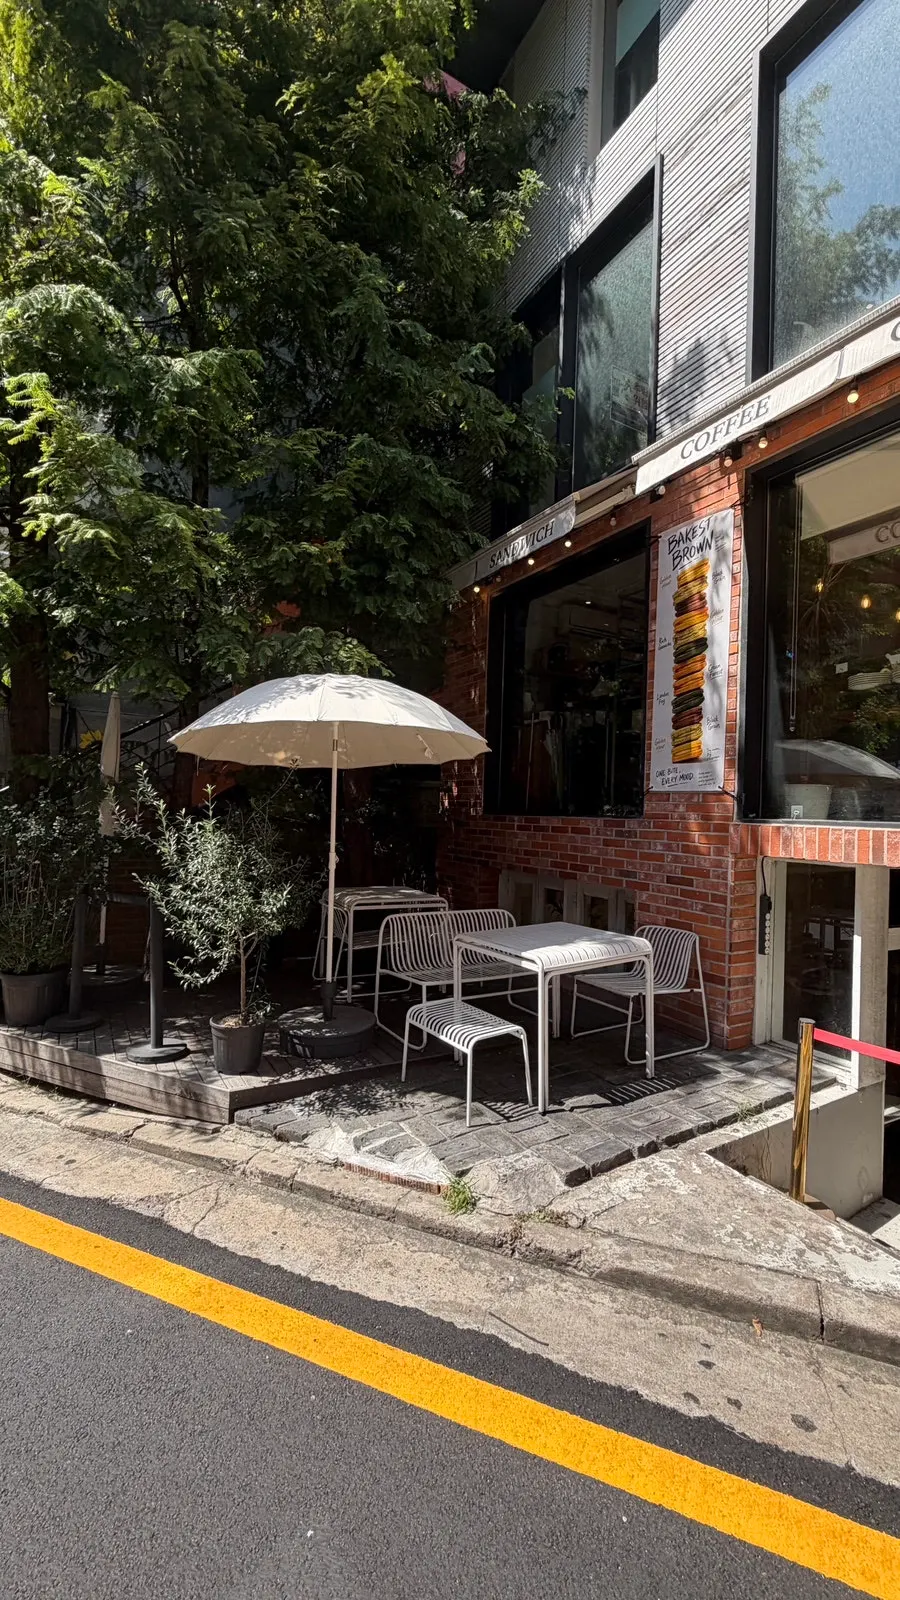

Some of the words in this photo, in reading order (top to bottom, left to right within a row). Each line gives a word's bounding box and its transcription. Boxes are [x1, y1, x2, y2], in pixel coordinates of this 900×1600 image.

[680, 394, 772, 460] COFFEE
[489, 520, 556, 569] SANDWICH
[667, 515, 713, 555] BAKEST
[671, 530, 714, 571] BROWN
[655, 769, 666, 778] ONE
[661, 777, 678, 785] EVERY
